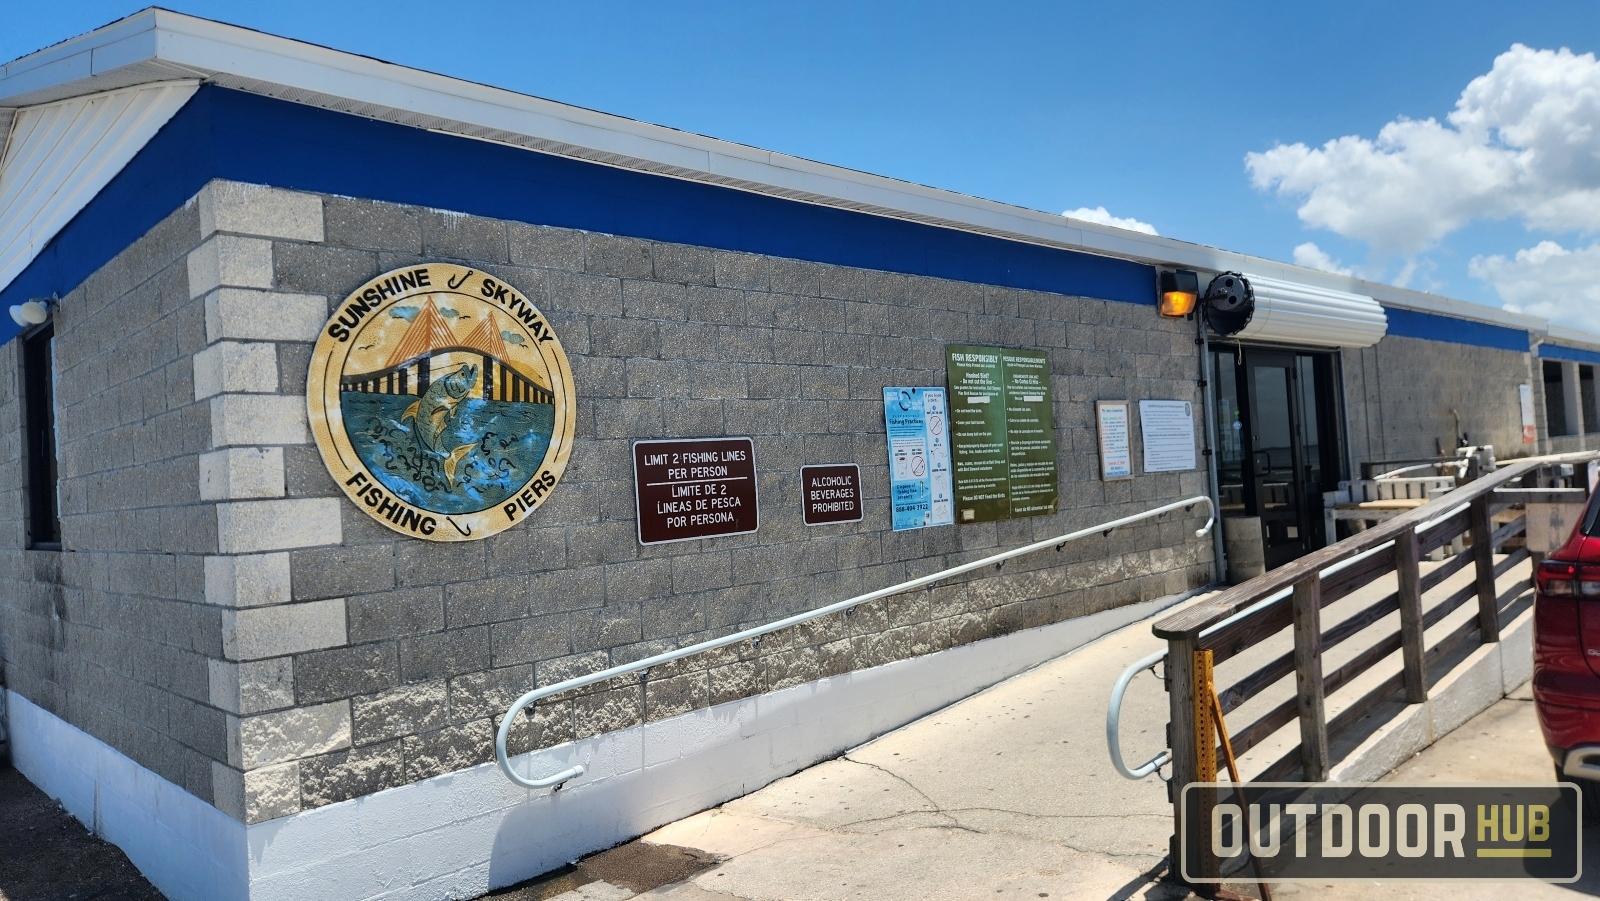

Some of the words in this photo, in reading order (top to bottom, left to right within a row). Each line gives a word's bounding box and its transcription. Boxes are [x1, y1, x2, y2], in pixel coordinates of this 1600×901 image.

[328, 269, 431, 342] SUNSHINE
[481, 278, 553, 345] SKYWAY
[951, 353, 965, 362] FISH
[965, 353, 999, 364] RESPONSIBLY
[889, 418, 905, 426] Fishing
[644, 454, 669, 466] LIMIT
[672, 453, 680, 464] 2
[683, 451, 719, 464] FISHING
[721, 450, 746, 462] LINES
[668, 468, 688, 479] PER
[691, 466, 728, 478] PERSON
[811, 475, 852, 488] ALCOHOLIC
[705, 484, 717, 495] DE
[720, 485, 727, 495] 2
[810, 488, 854, 501] BEVERAGES
[346, 471, 437, 535] FISHING
[503, 470, 556, 521] PIERS
[695, 500, 708, 511] DE
[711, 497, 741, 509] PESCA
[812, 501, 854, 513] PROHIBITED
[667, 517, 687, 529] POR
[690, 512, 735, 526] PERSONA
